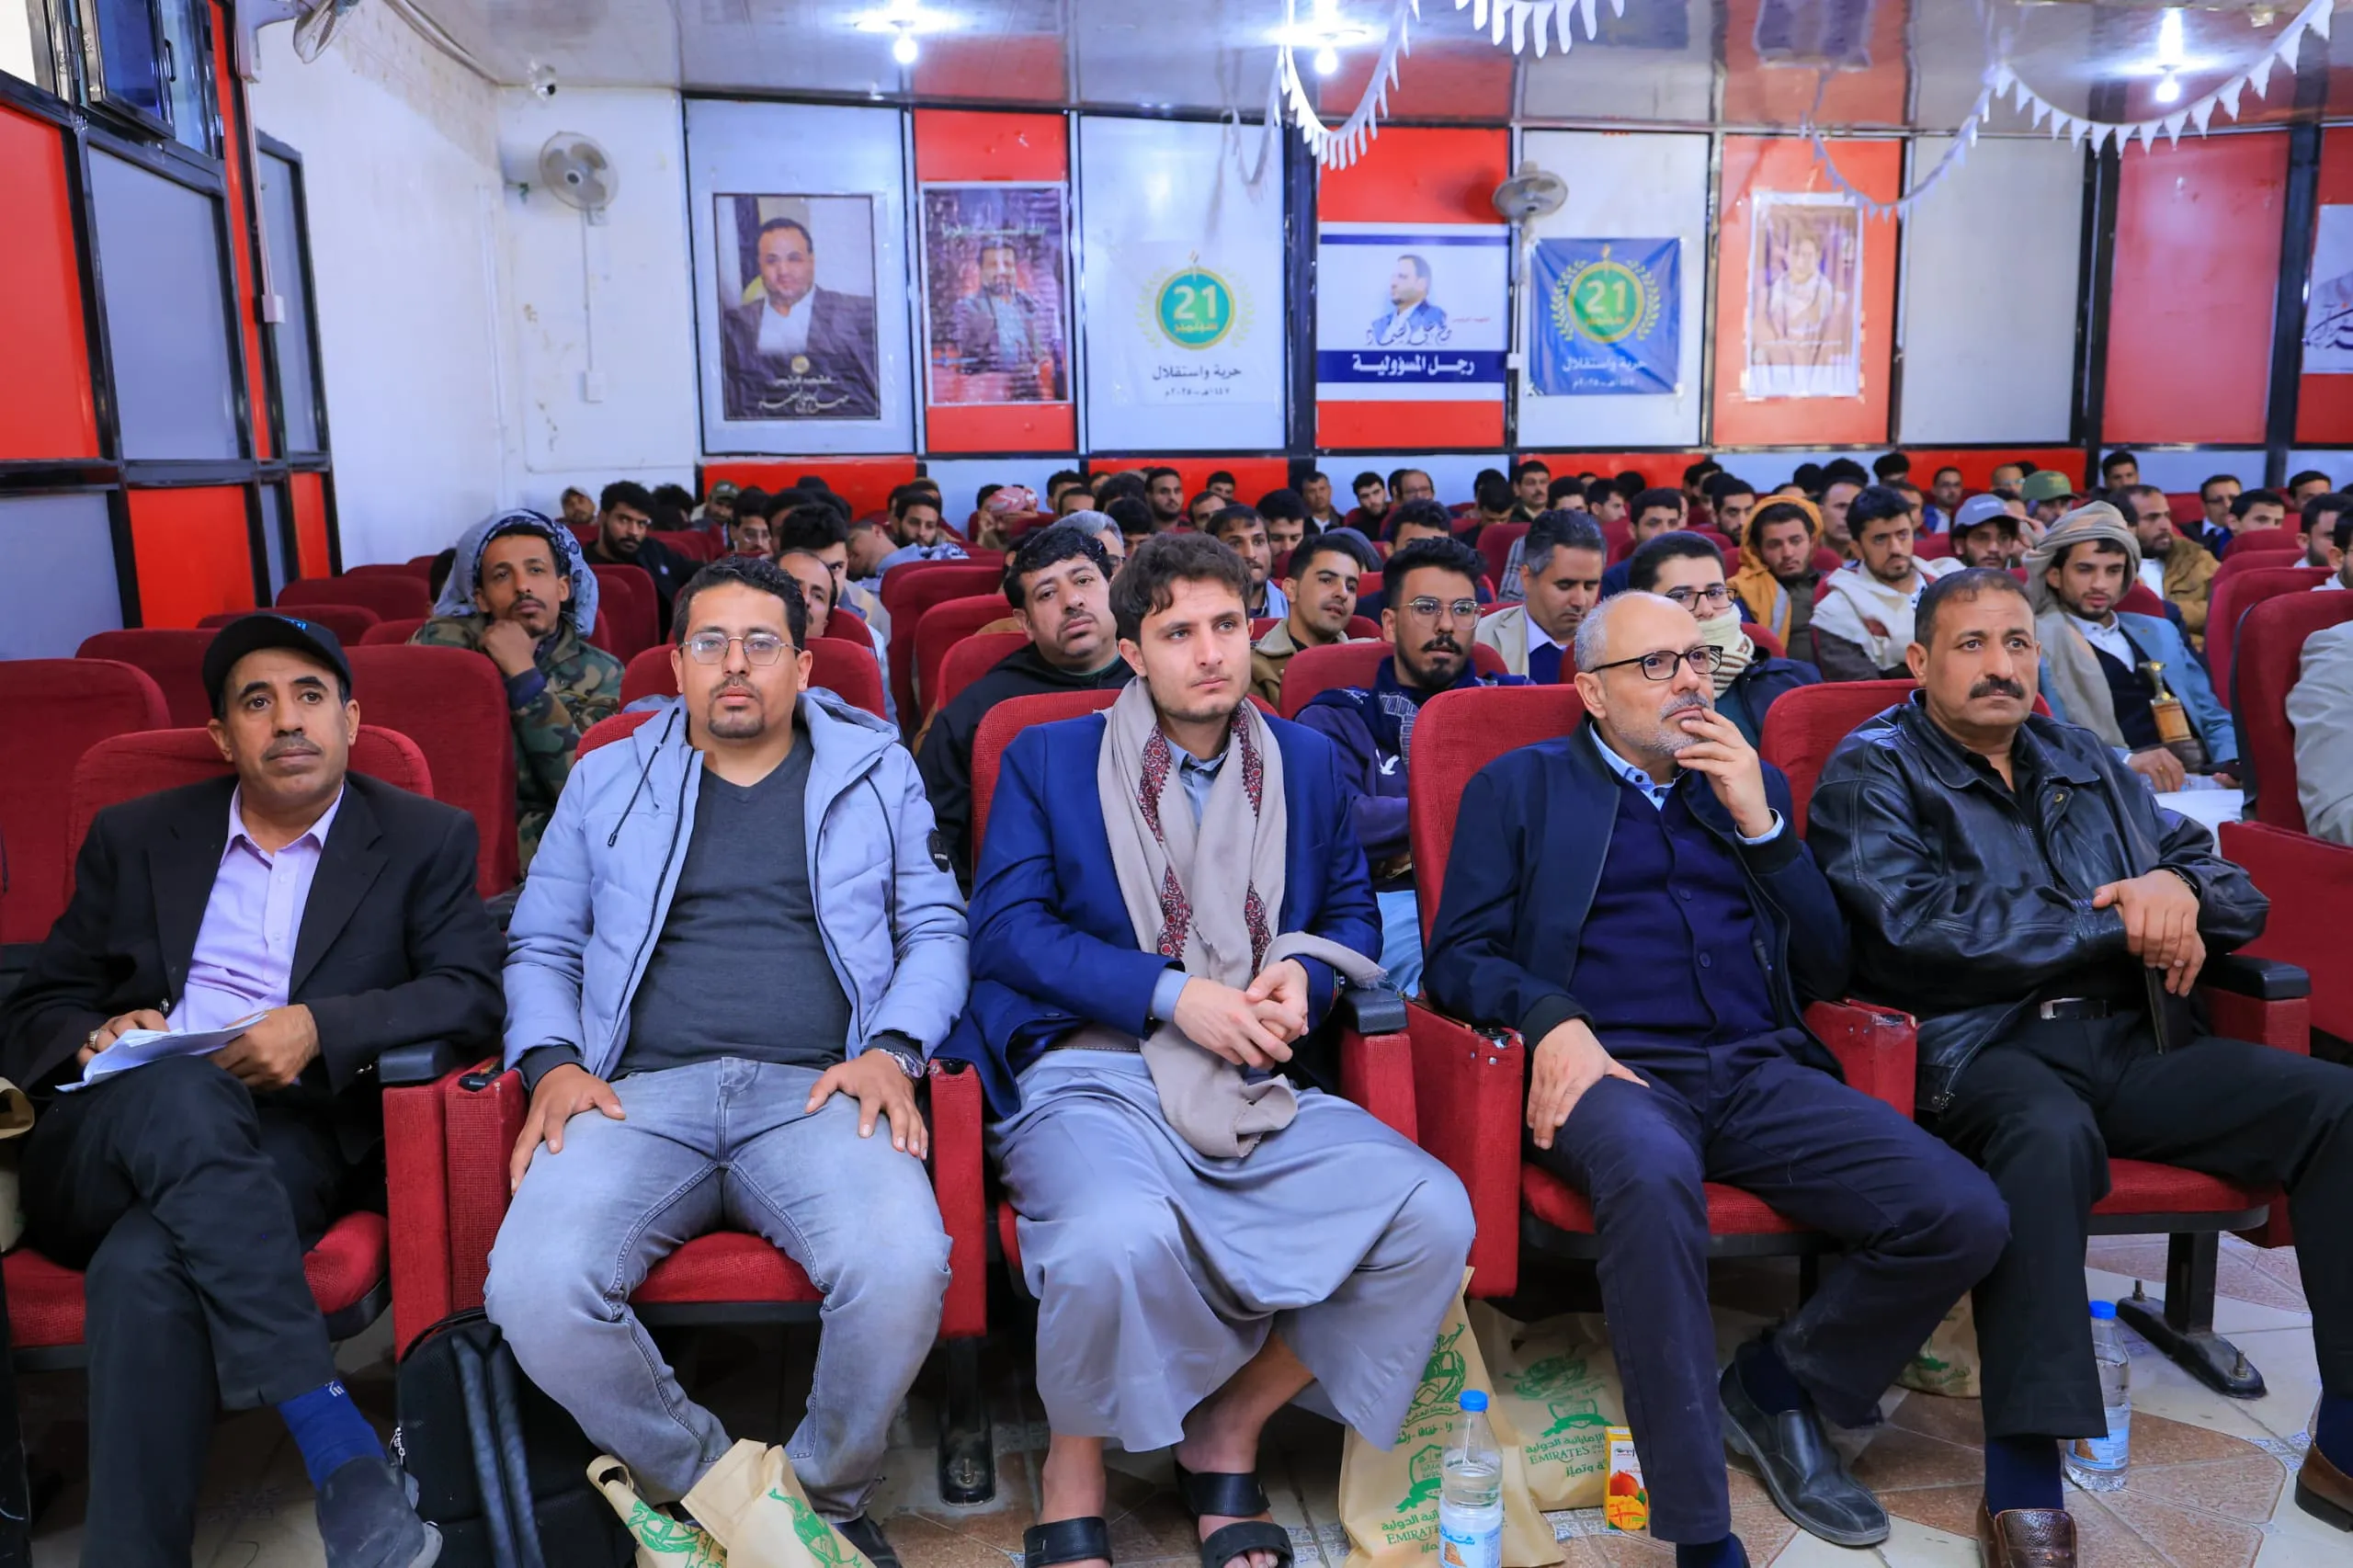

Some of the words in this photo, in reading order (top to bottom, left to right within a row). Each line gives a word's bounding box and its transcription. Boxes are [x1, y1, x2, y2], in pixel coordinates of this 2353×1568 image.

[1174, 285, 1217, 320] 21
[1586, 279, 1626, 313] 21
[1153, 365, 1210, 381] واستقلال
[1214, 364, 1242, 380] حرية
[1427, 355, 1475, 376] رجل
[1526, 1438, 1562, 1454] الدولية
[1529, 1446, 1591, 1465] EMIRATES
[1381, 1514, 1420, 1532] الدولية
